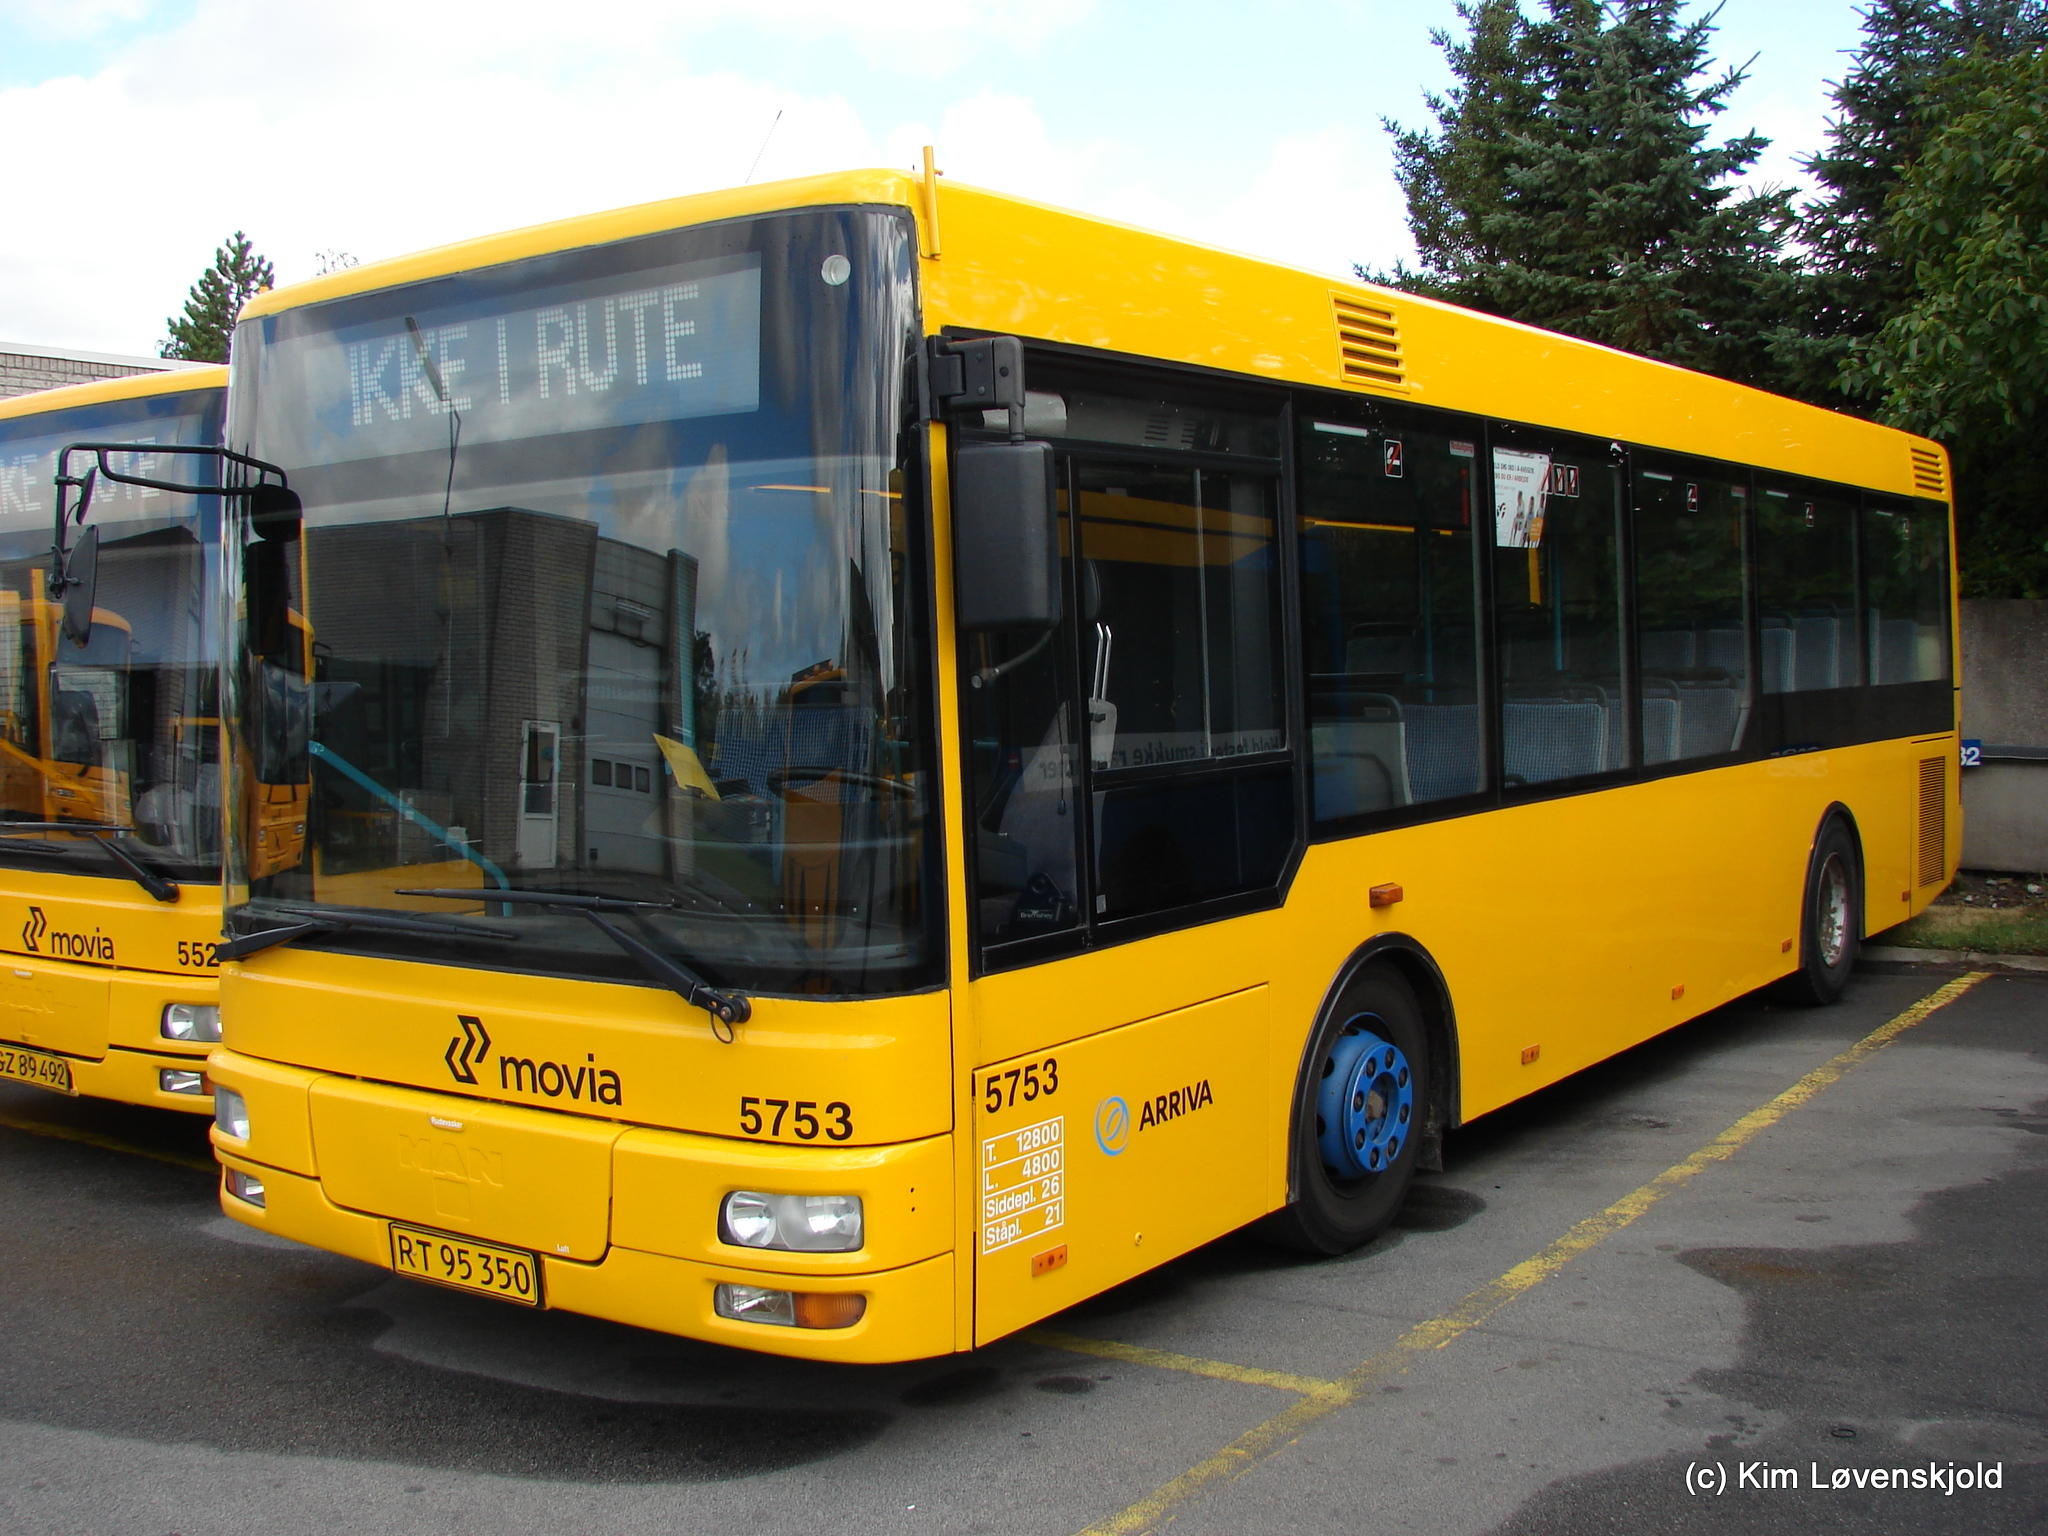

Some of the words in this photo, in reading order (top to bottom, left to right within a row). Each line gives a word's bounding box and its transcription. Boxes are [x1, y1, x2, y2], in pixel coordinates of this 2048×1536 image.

[349, 324, 473, 426] IKKE
[497, 317, 511, 405] I
[536, 283, 703, 399] RUTE
[0, 453, 42, 515] KE
[50, 926, 115, 960] movia
[177, 940, 221, 968] 552
[18, 1054, 38, 1079] 89
[39, 1059, 66, 1086] 492
[499, 1052, 623, 1106] movia
[985, 1057, 1059, 1114] 5753
[739, 1096, 854, 1142] 5753
[1138, 1079, 1214, 1132] ARRIVA
[398, 1133, 504, 1187] MAN
[985, 1143, 997, 1163] T.
[1016, 1121, 1060, 1154] 12800
[984, 1172, 999, 1191] L.
[1021, 1149, 1060, 1179] 4800
[985, 1185, 1037, 1219] Siddepl.
[1041, 1175, 1060, 1200] 26
[985, 1217, 1023, 1246] Ståpl.
[1044, 1202, 1061, 1226] 21
[397, 1234, 433, 1272] RT
[439, 1243, 473, 1280] 95
[478, 1252, 531, 1295] 350
